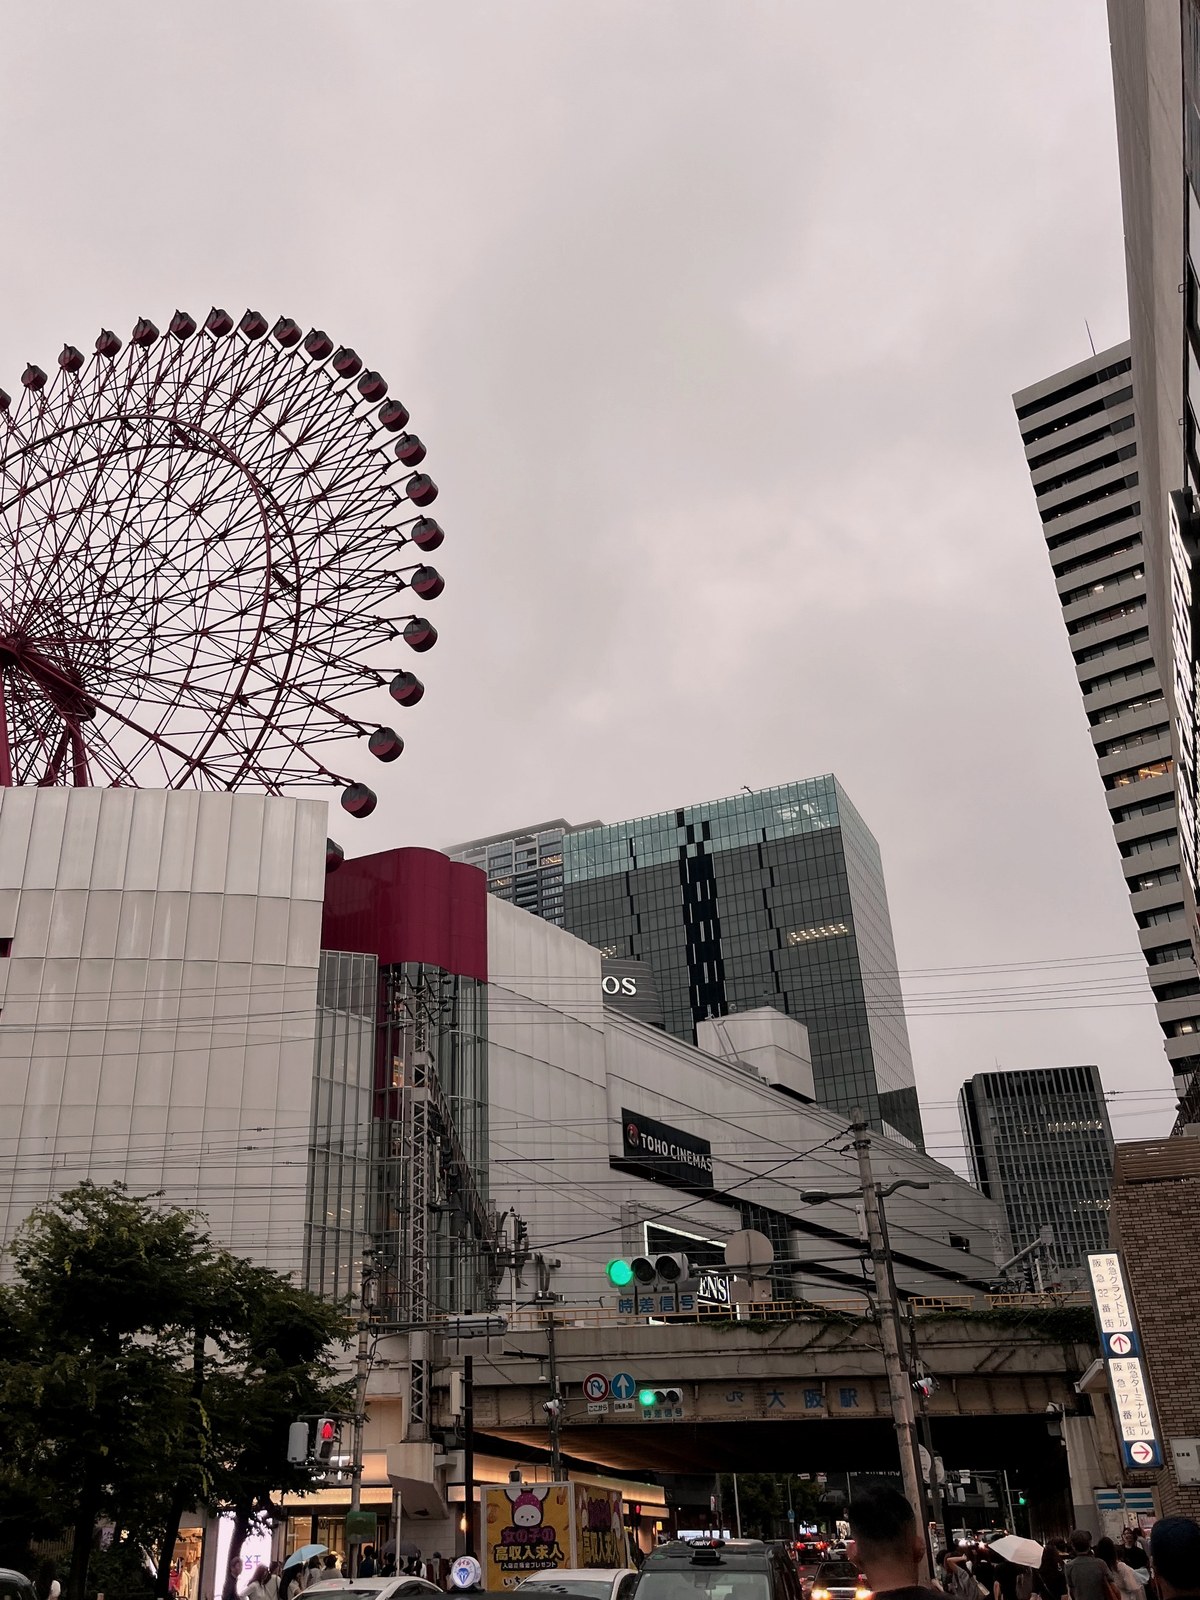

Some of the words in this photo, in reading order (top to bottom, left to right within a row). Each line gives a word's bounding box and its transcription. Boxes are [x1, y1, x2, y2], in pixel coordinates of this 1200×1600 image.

[602, 976, 637, 996] OS
[641, 1133, 669, 1157] TOHO
[670, 1146, 713, 1173] CINEMAS
[1106, 1258, 1128, 1327] 阪急グランドビル
[618, 1294, 695, 1314] 時差信号
[1127, 1362, 1150, 1436] 阪急ターミナルビル
[643, 1408, 683, 1418] 時差信号
[495, 1543, 563, 1561] 高収入求人
